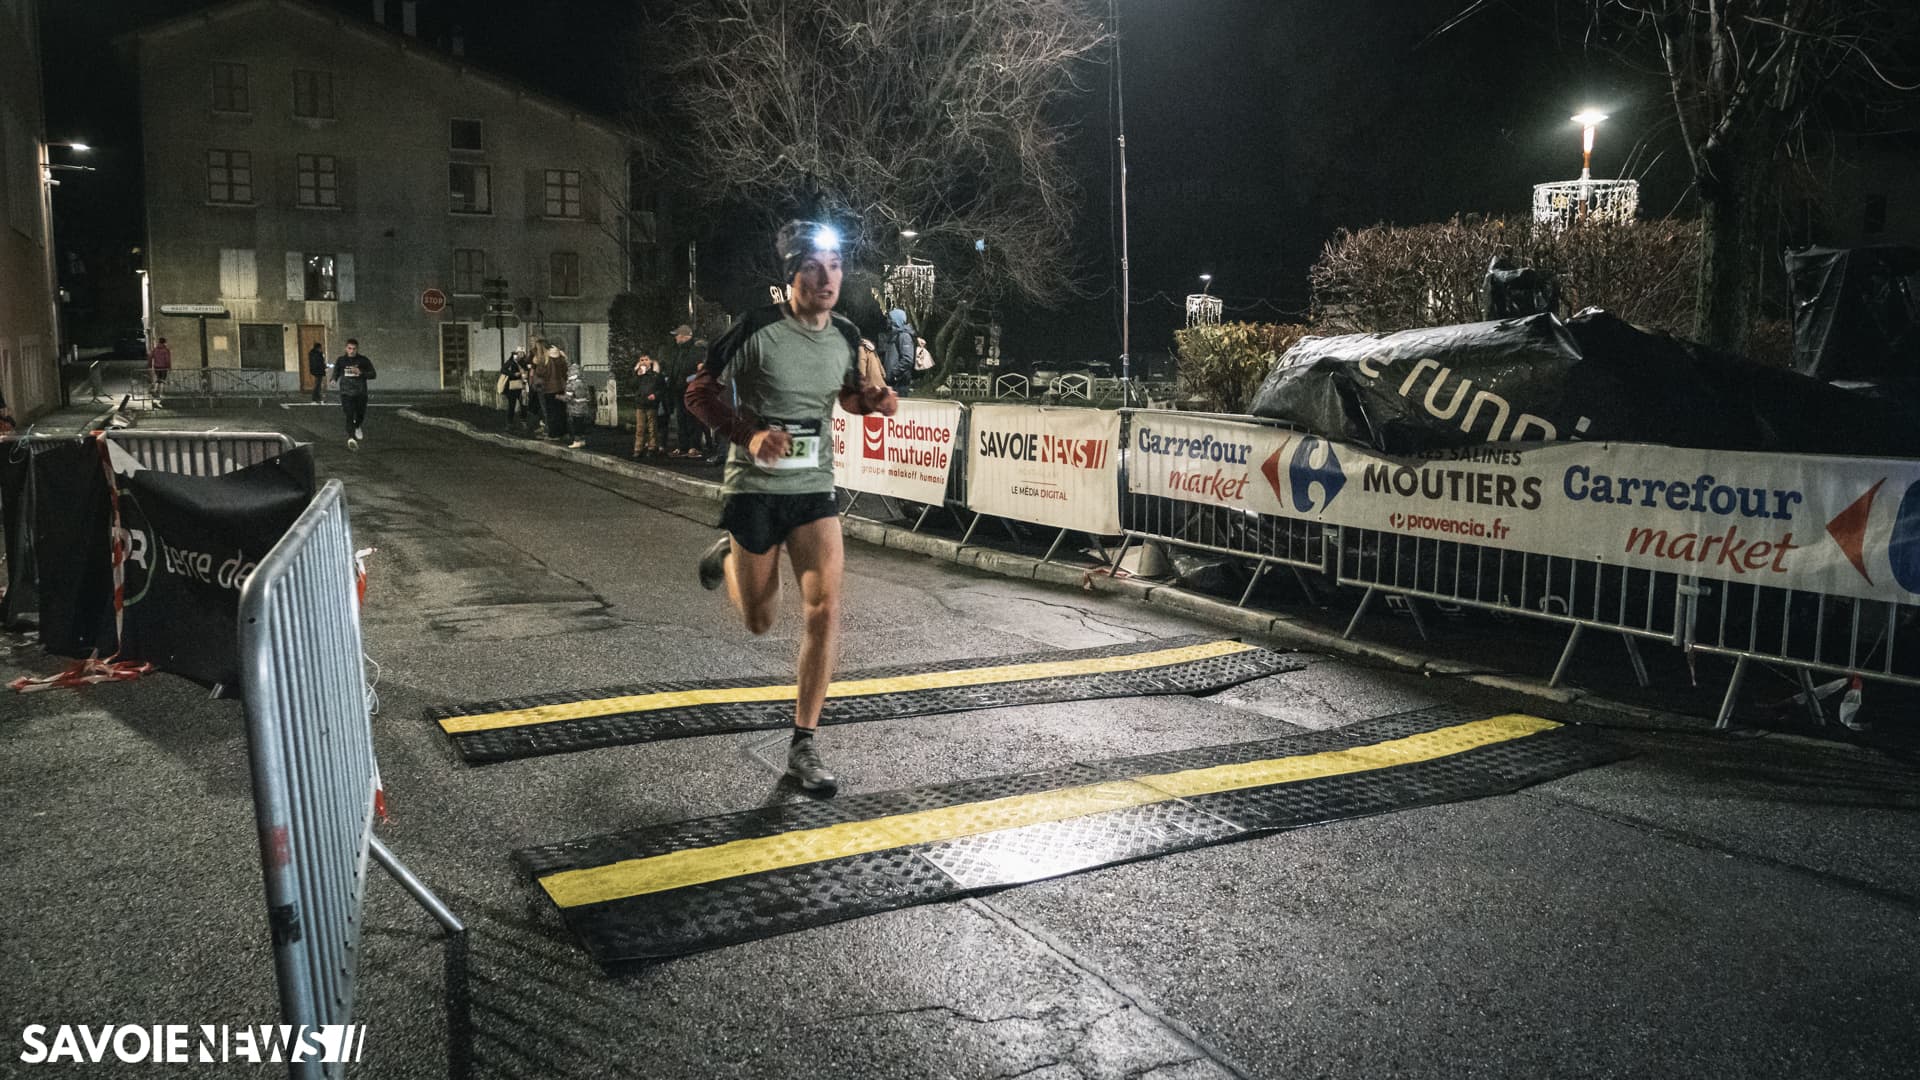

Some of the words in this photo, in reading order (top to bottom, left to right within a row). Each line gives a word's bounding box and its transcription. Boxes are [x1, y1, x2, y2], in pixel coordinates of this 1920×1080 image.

[423, 295, 443, 305] STOP
[887, 418, 951, 444] Radiance
[887, 446, 948, 470] mutuelle
[979, 430, 1038, 462] SAVOIE
[1138, 427, 1253, 465] Carrefour
[1450, 447, 1522, 466] SALINES
[888, 468, 917, 480] malakoff
[919, 473, 945, 485] humanis
[1168, 468, 1250, 501] market
[1363, 463, 1543, 511] MOUTIERS
[1011, 485, 1018, 495] LE
[1019, 485, 1040, 498] MÉDIA
[1040, 488, 1068, 501] DIGITAL
[1563, 464, 1803, 521] Carrefour
[1407, 514, 1511, 540] provencia.fr
[159, 535, 212, 584] terre
[1624, 525, 1800, 574] market
